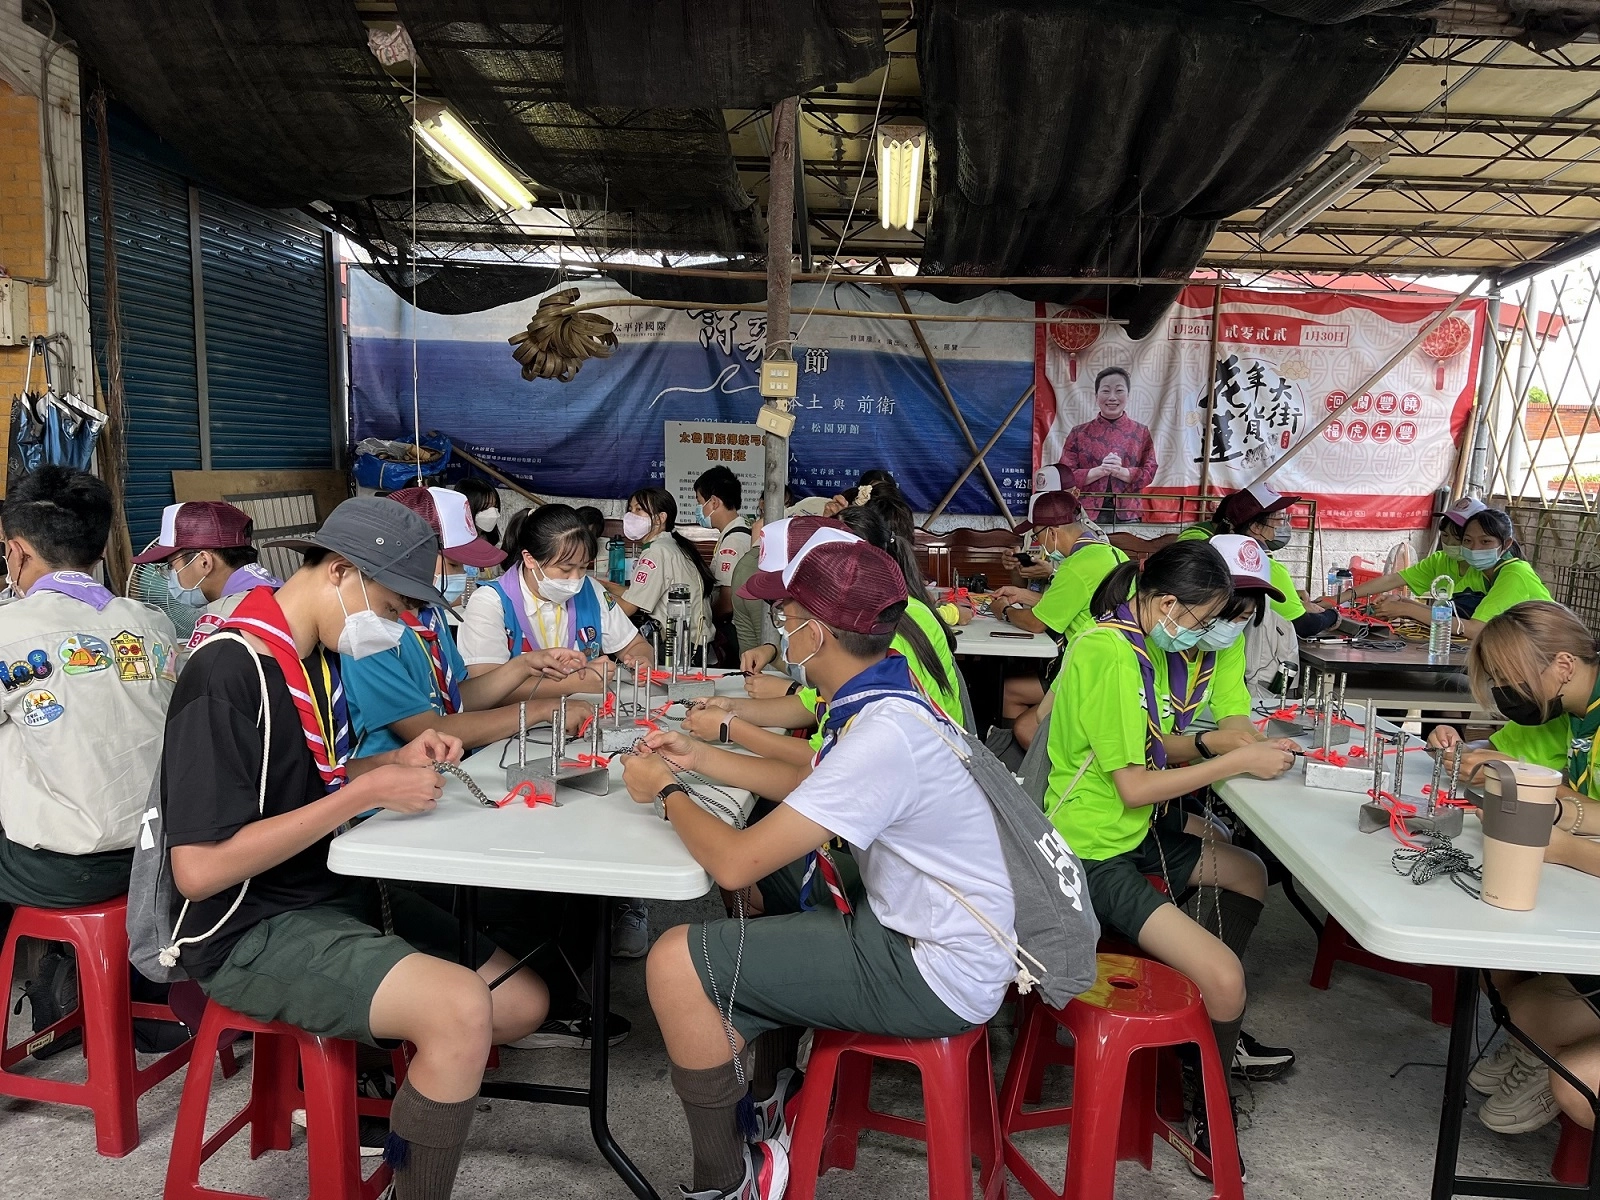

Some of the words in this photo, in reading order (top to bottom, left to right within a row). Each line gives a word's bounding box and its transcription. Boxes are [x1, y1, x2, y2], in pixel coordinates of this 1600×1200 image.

[614, 321, 666, 332] 太平洋國際
[1174, 323, 1209, 338] 1月26日
[1225, 325, 1287, 341] 貳零貳貳
[1305, 330, 1344, 342] 1月30日
[857, 394, 896, 415] 前衛
[811, 422, 860, 434] 松園別館
[706, 448, 747, 461] 初階班
